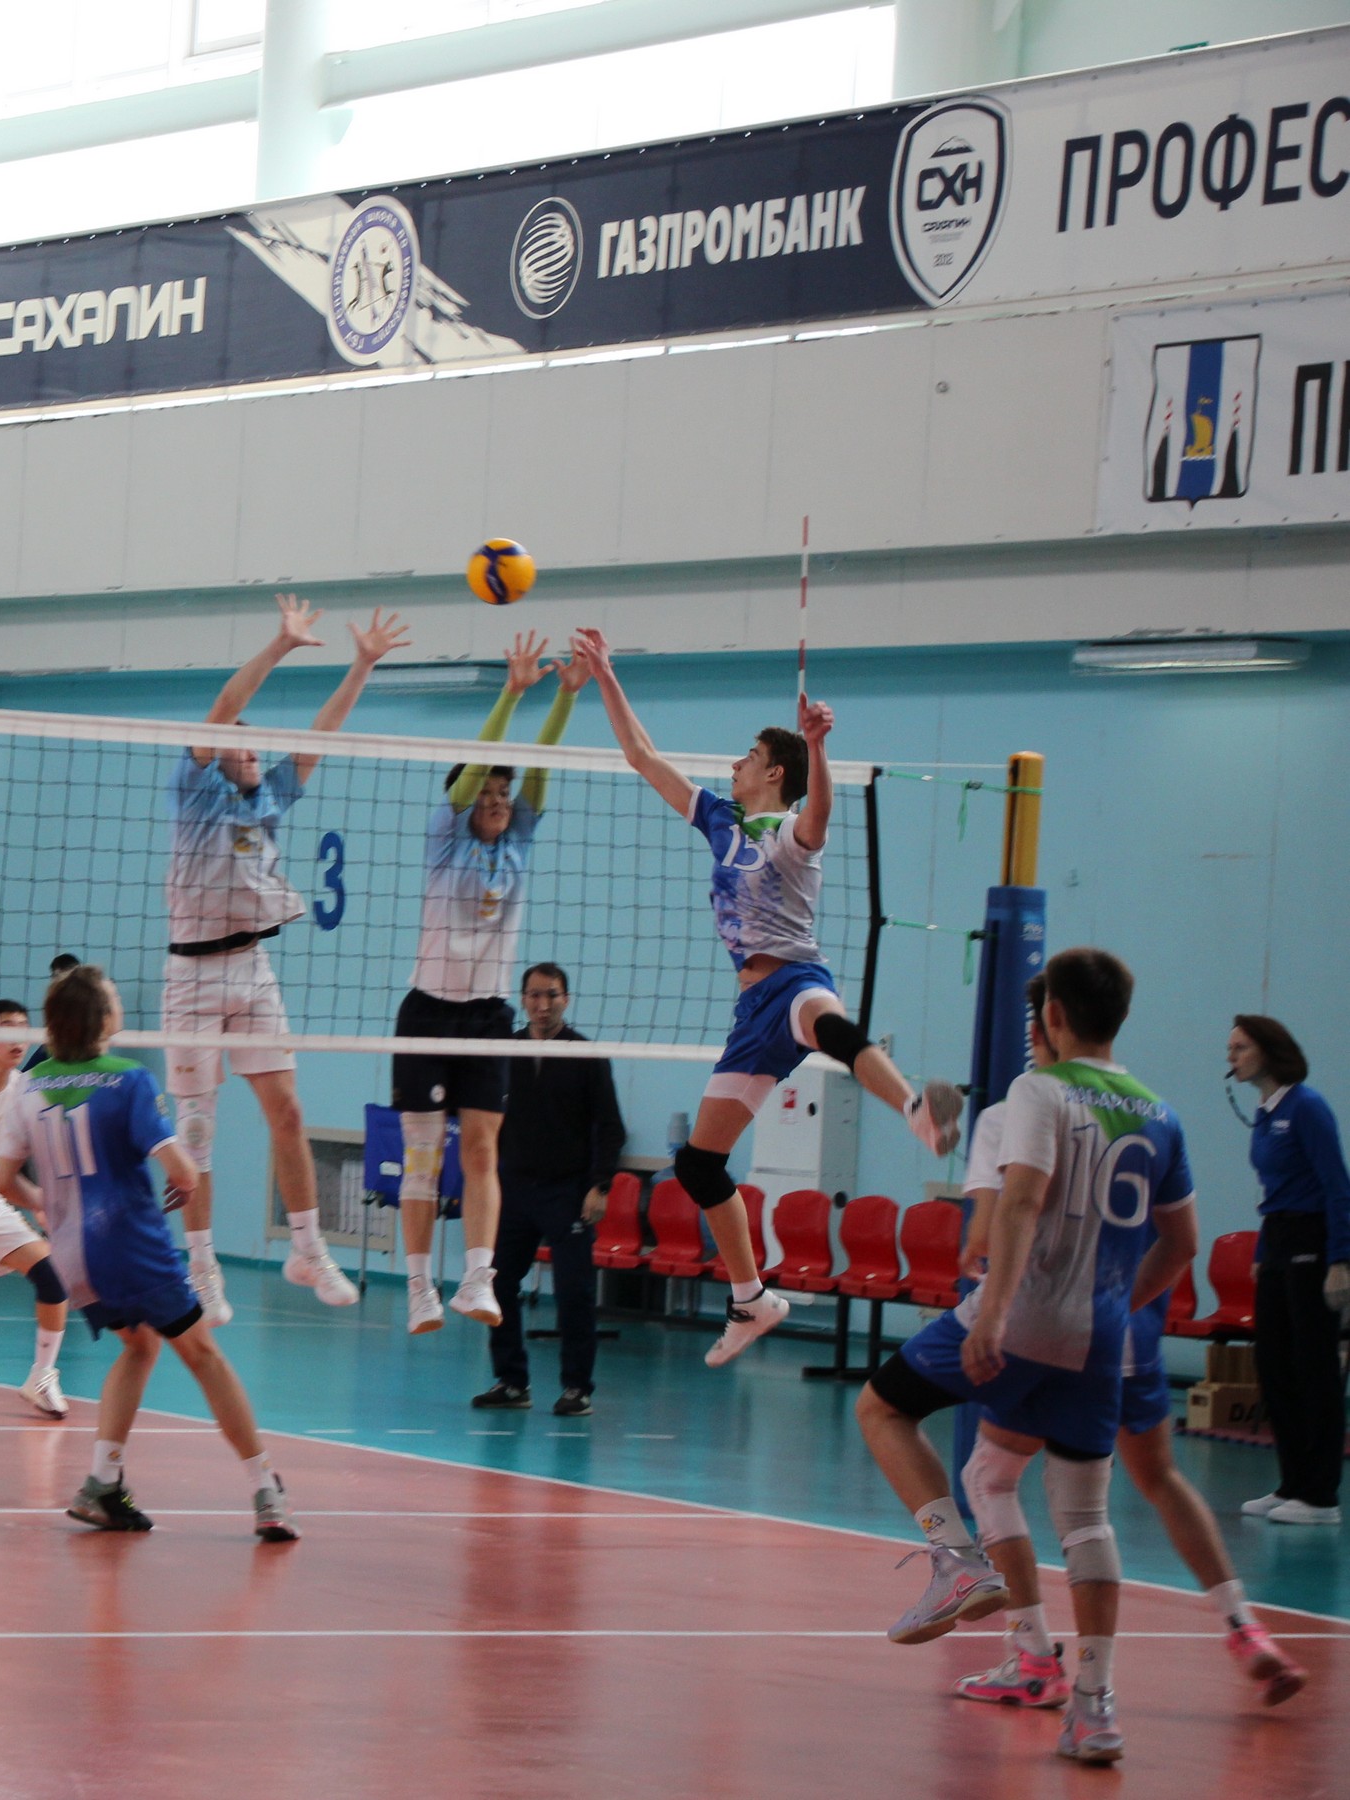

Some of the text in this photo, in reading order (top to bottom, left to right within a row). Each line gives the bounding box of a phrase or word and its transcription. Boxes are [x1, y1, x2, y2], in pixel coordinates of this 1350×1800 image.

[1057, 96, 1350, 232] ПРОФЕС
[597, 187, 864, 278] ГАЗПРОМБАНК
[313, 832, 345, 931] 3
[721, 823, 768, 871] 15
[36, 1102, 98, 1179] 11
[1065, 1122, 1157, 1228] 16
